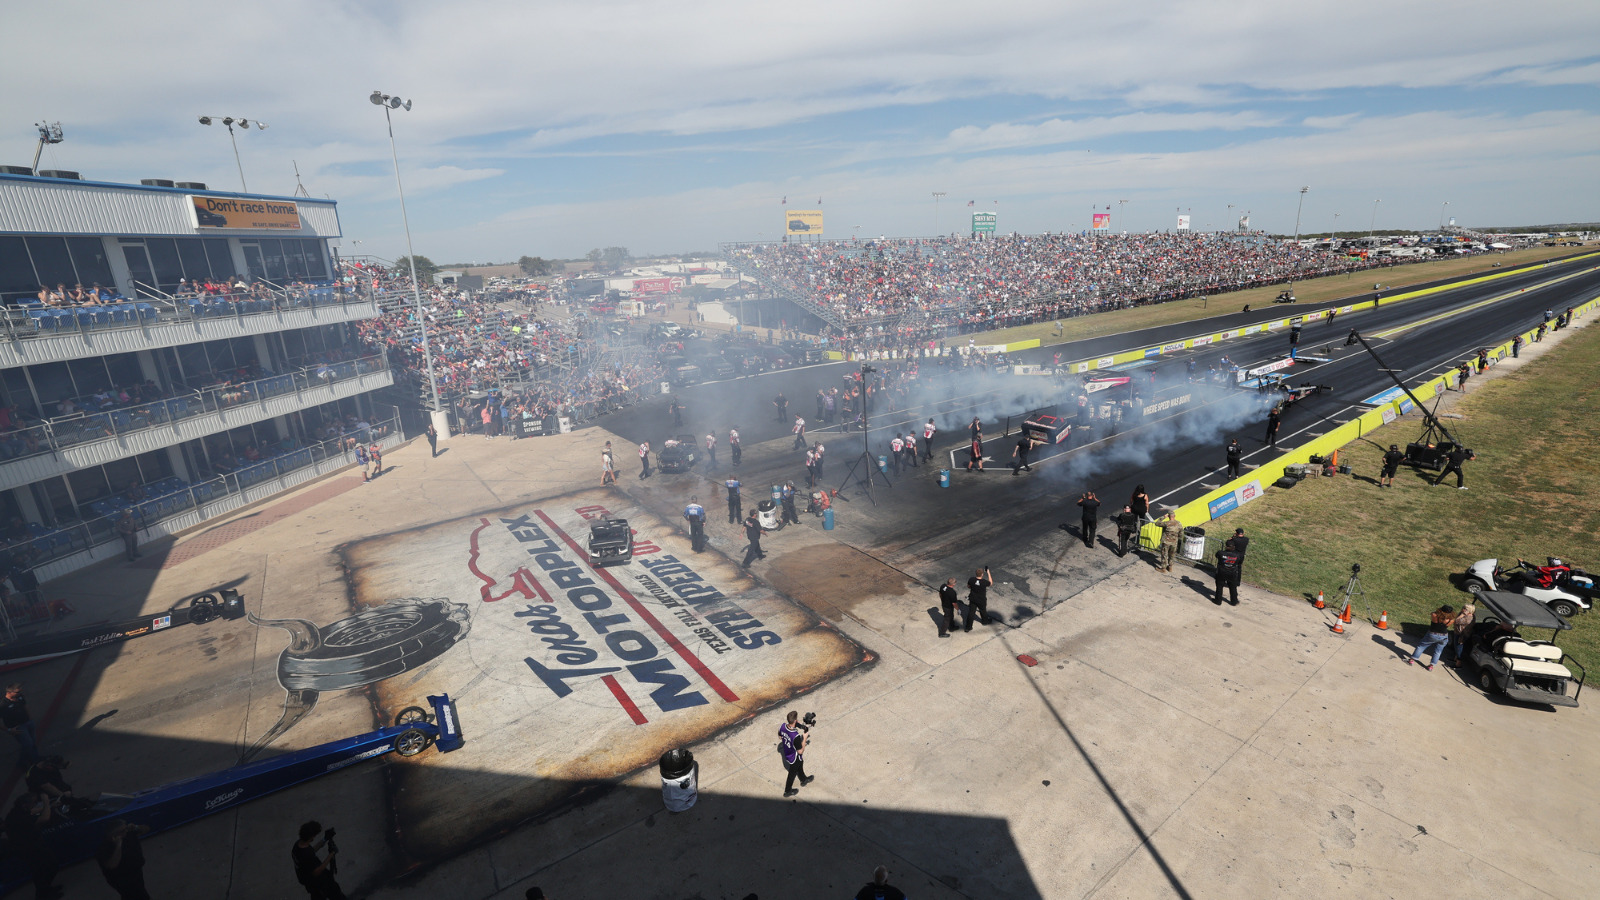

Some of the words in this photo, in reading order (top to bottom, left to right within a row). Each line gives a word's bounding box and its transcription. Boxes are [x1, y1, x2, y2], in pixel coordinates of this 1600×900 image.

[206, 199, 239, 212] Don't
[240, 203, 264, 213] race
[265, 202, 298, 214] home.
[1143, 403, 1158, 416] WHERE
[1157, 400, 1170, 412] SPEED
[1170, 397, 1180, 407] WAS
[635, 574, 685, 609] NATIONALS
[638, 554, 782, 650] STAMPEDE
[500, 514, 710, 712] MOTORPLEX
[673, 609, 702, 627] FALL
[81, 637, 99, 646] Fast
[514, 604, 622, 698] Texas
[693, 627, 732, 655] TEXAS
